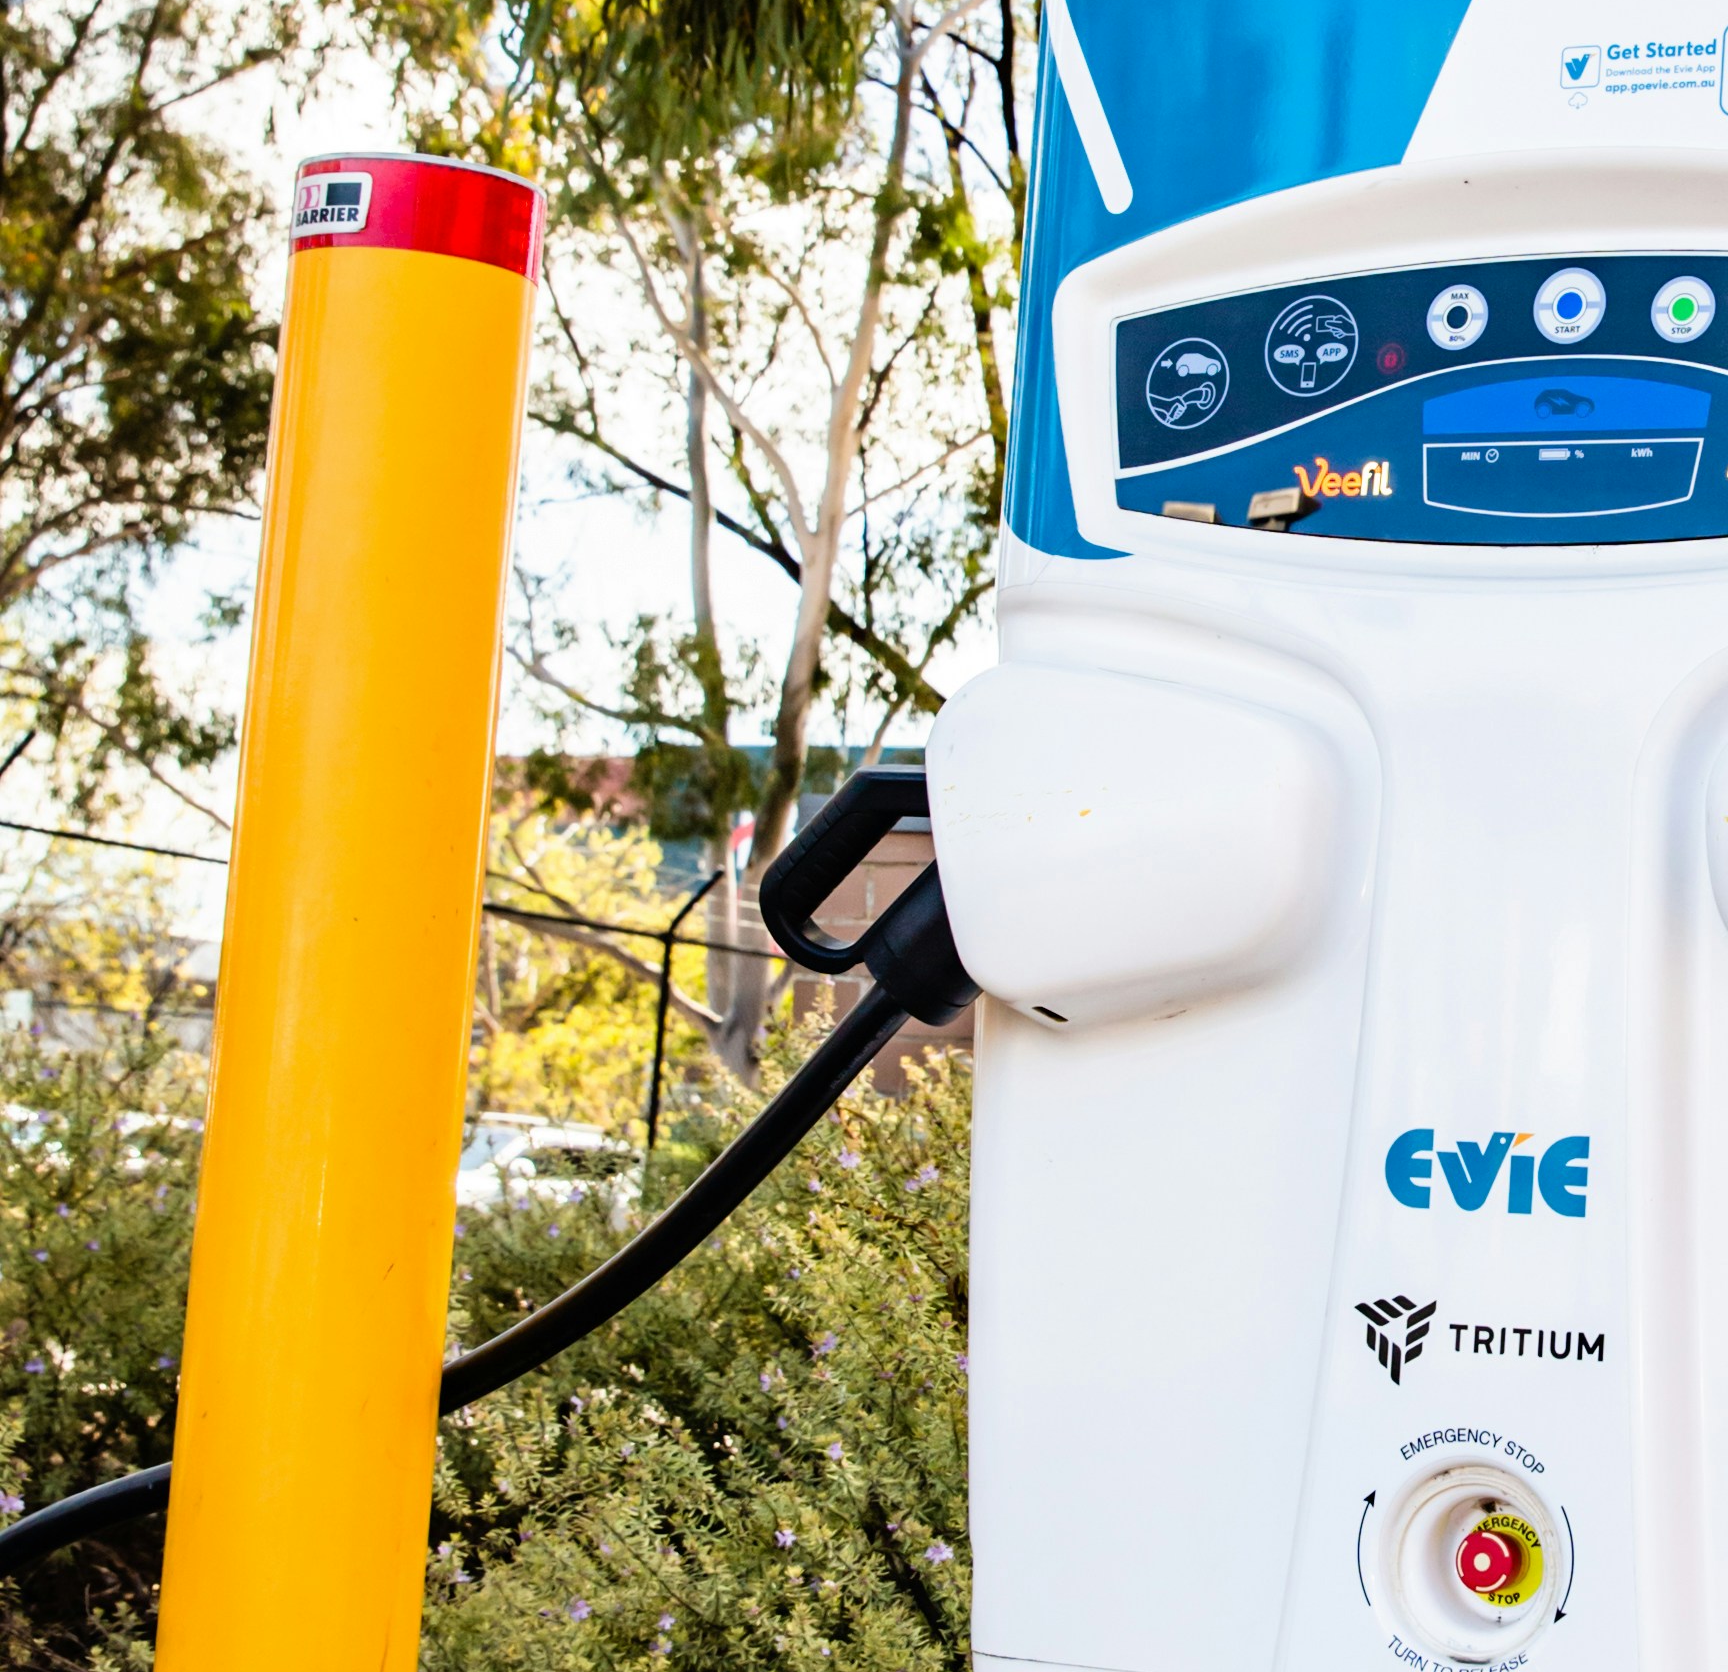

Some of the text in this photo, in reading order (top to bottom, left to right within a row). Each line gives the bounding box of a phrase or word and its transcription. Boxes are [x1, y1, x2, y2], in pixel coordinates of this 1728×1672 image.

[1606, 38, 1717, 60] Get Started
[1605, 64, 1716, 77] Download the Evie App
[1605, 79, 1716, 95] app.goevie.com.au
[295, 207, 360, 227] BARRIER
[1450, 292, 1470, 301] MAX
[1554, 325, 1581, 334] START
[1671, 327, 1693, 335] STOP
[1449, 335, 1467, 343] 80%
[1279, 348, 1300, 359] SMS
[1322, 346, 1342, 358] APP
[1460, 451, 1481, 461] MIN
[1630, 448, 1654, 458] kWh
[1294, 457, 1393, 497] Veefil
[1448, 1323, 1606, 1363] TRITIUM
[1400, 1427, 1545, 1477] EMERGENCY STOP
[1473, 1516, 1542, 1548] ERGENCY
[1487, 1592, 1521, 1605] STOP
[1388, 1633, 1427, 1672] TURN
